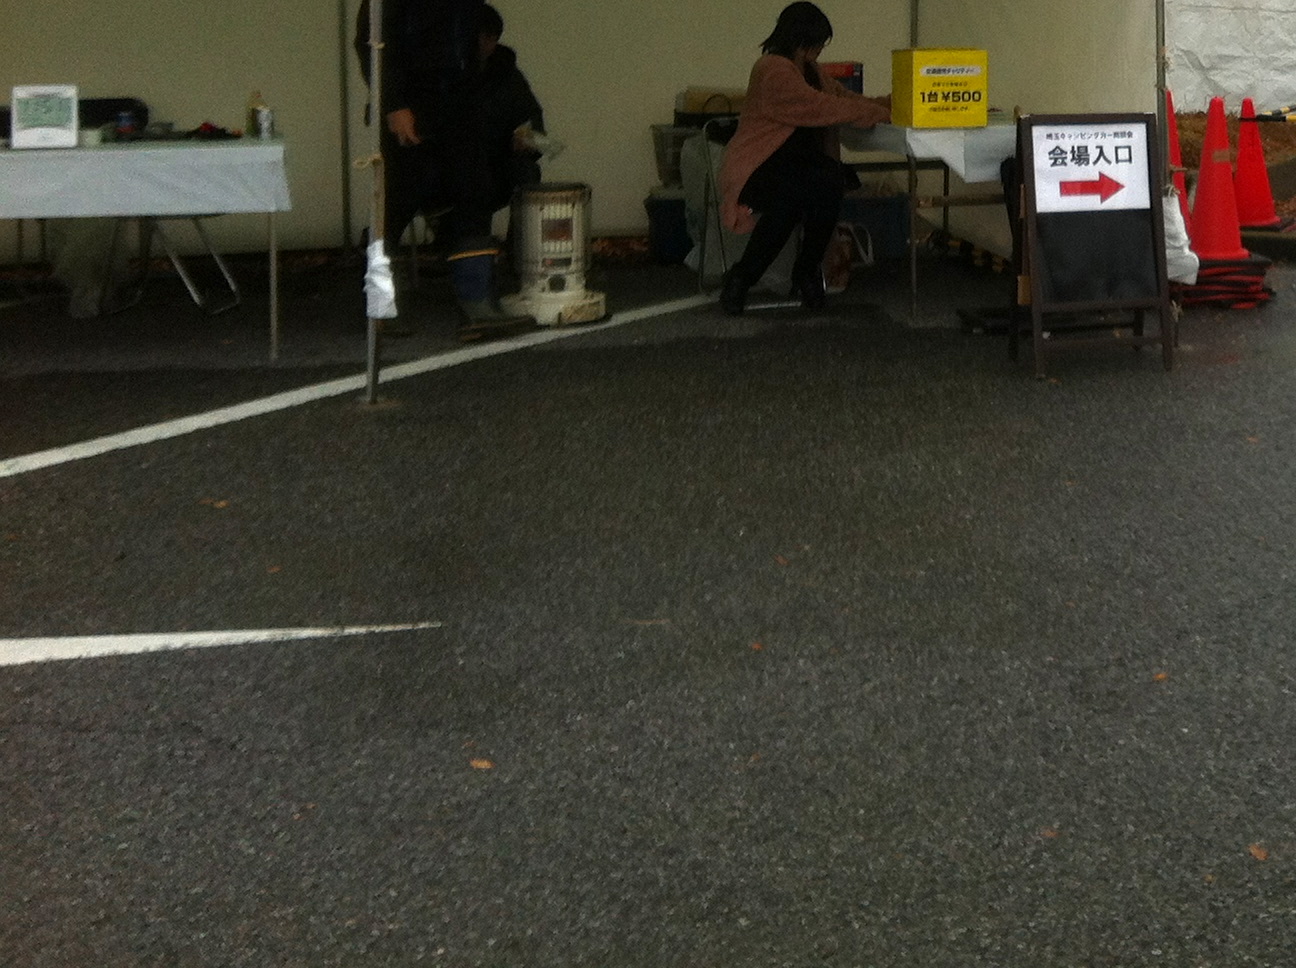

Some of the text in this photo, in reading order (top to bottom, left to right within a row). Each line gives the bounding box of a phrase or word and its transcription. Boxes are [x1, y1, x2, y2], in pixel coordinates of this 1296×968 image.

[941, 91, 982, 103] ¥500
[1048, 145, 1133, 168] 会場入口
